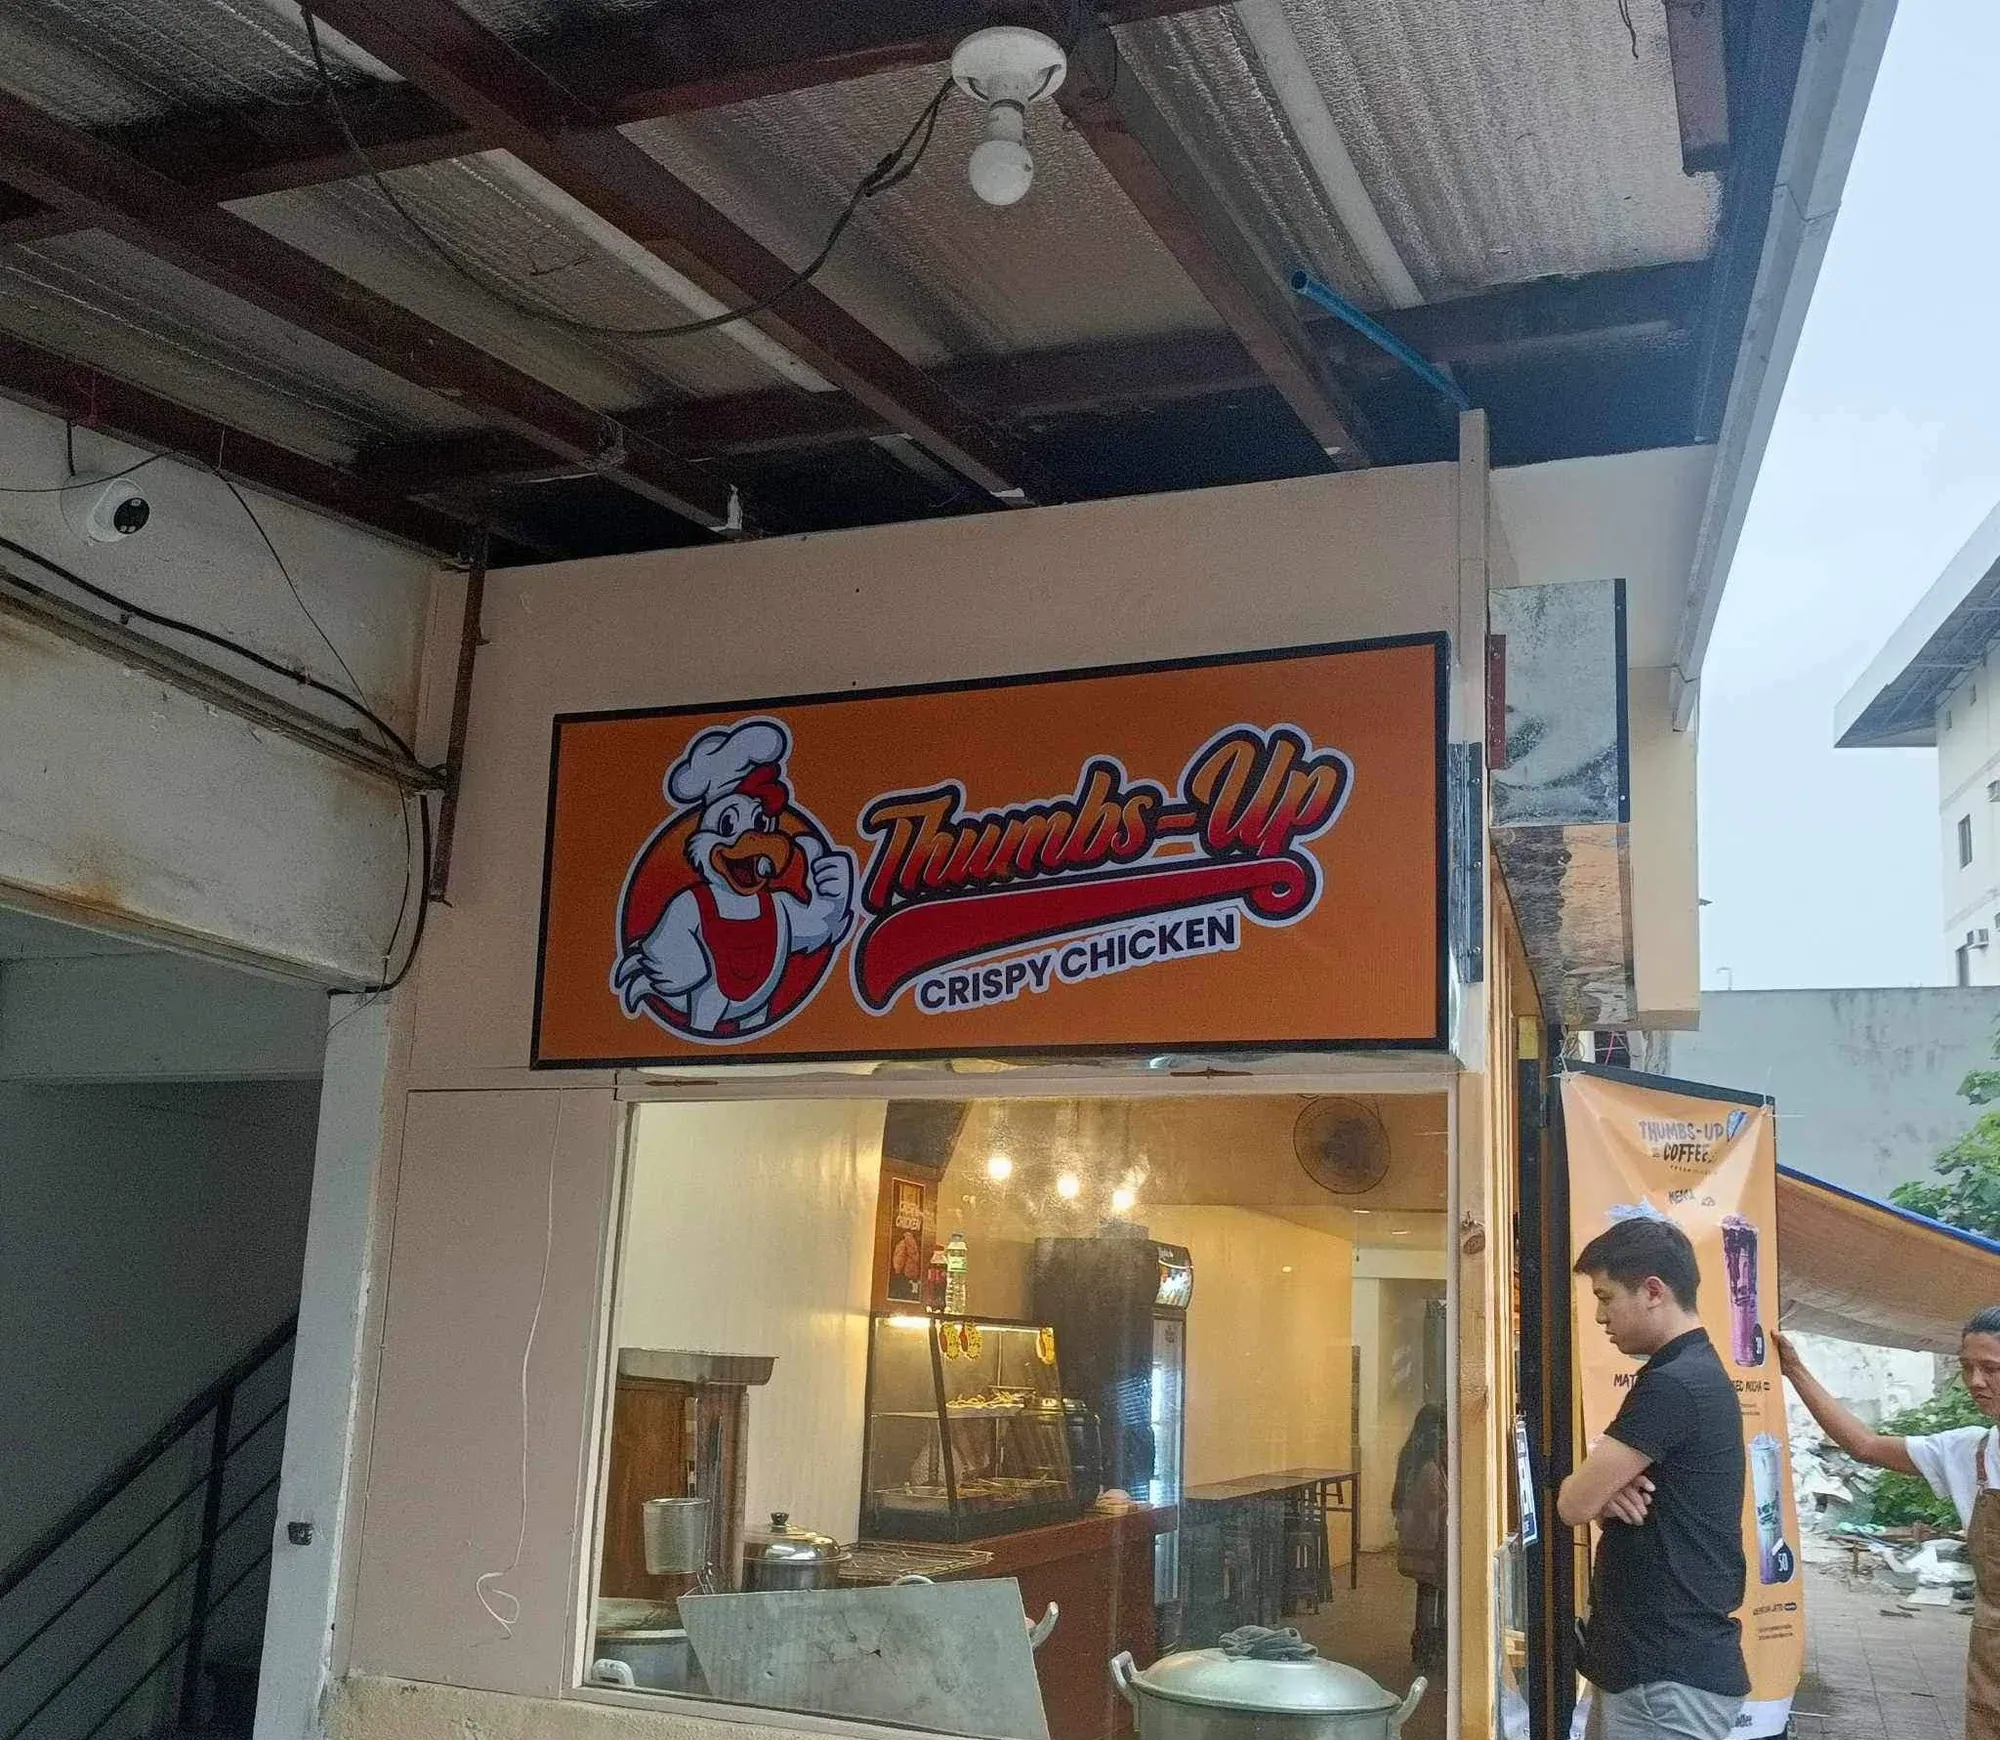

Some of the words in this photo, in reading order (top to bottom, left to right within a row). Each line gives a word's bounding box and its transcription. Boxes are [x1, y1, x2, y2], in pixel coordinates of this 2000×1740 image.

[865, 733, 1343, 911] Thumbs-Up
[920, 955, 1051, 1009] CRISPY
[1060, 913, 1235, 978] CHICKEN
[1638, 1120, 1724, 1141] THUMBS-UP
[1613, 1373, 1637, 1388] MAT
